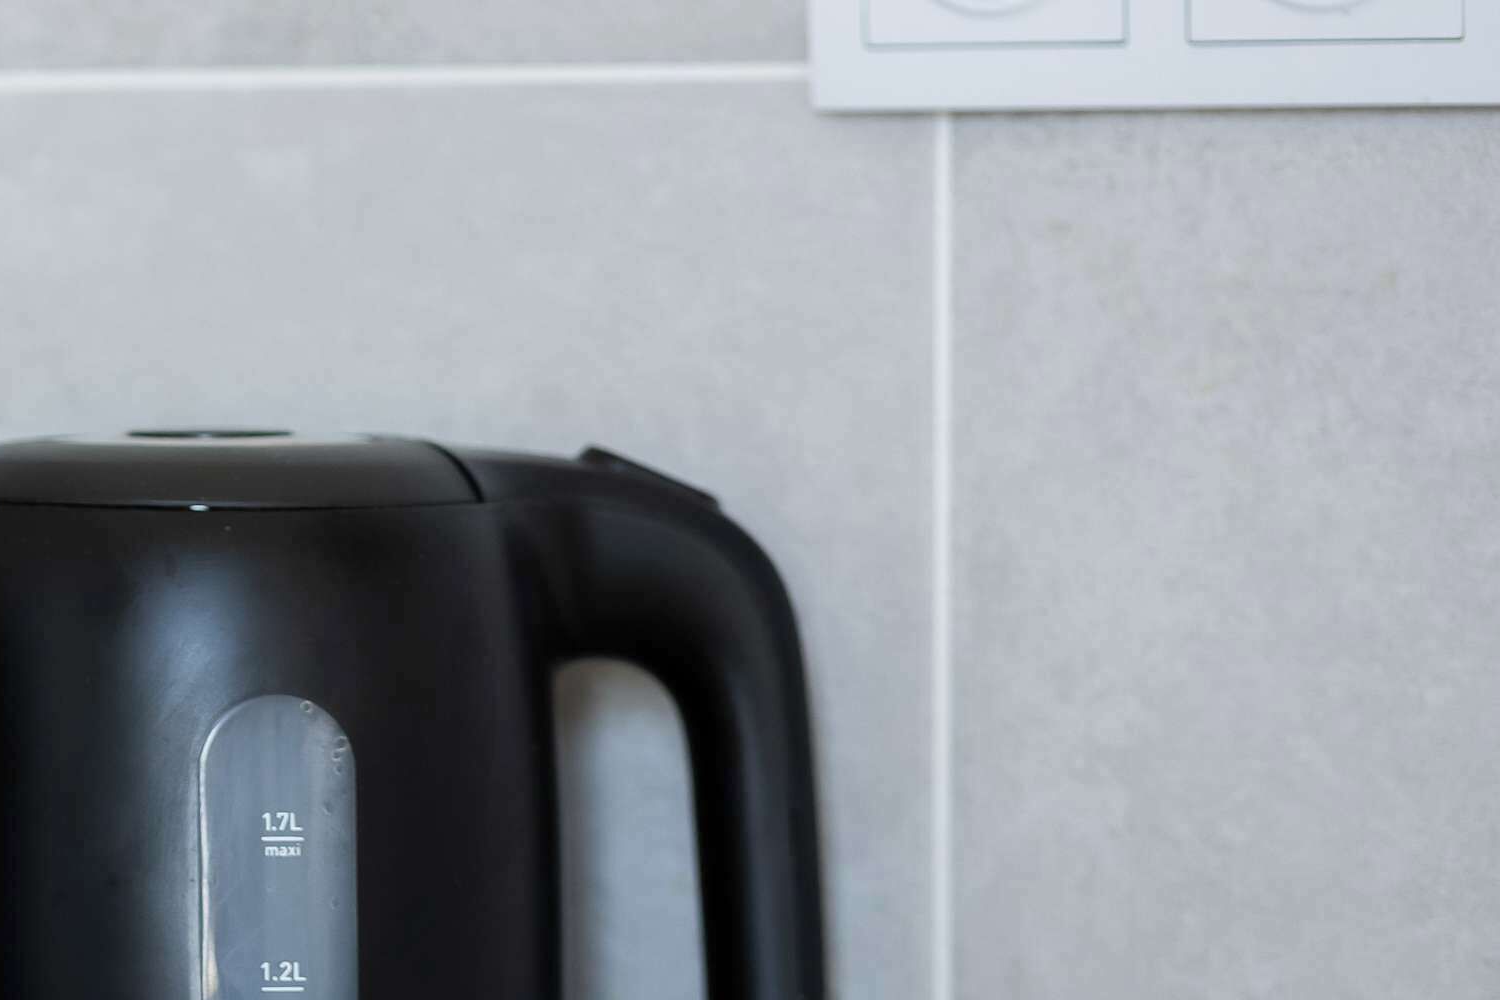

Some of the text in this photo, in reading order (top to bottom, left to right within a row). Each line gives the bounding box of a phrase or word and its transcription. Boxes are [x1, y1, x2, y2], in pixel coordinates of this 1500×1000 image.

[261, 812, 304, 831] 1.7L
[264, 842, 302, 857] maxi
[260, 961, 307, 982] 1.2L
